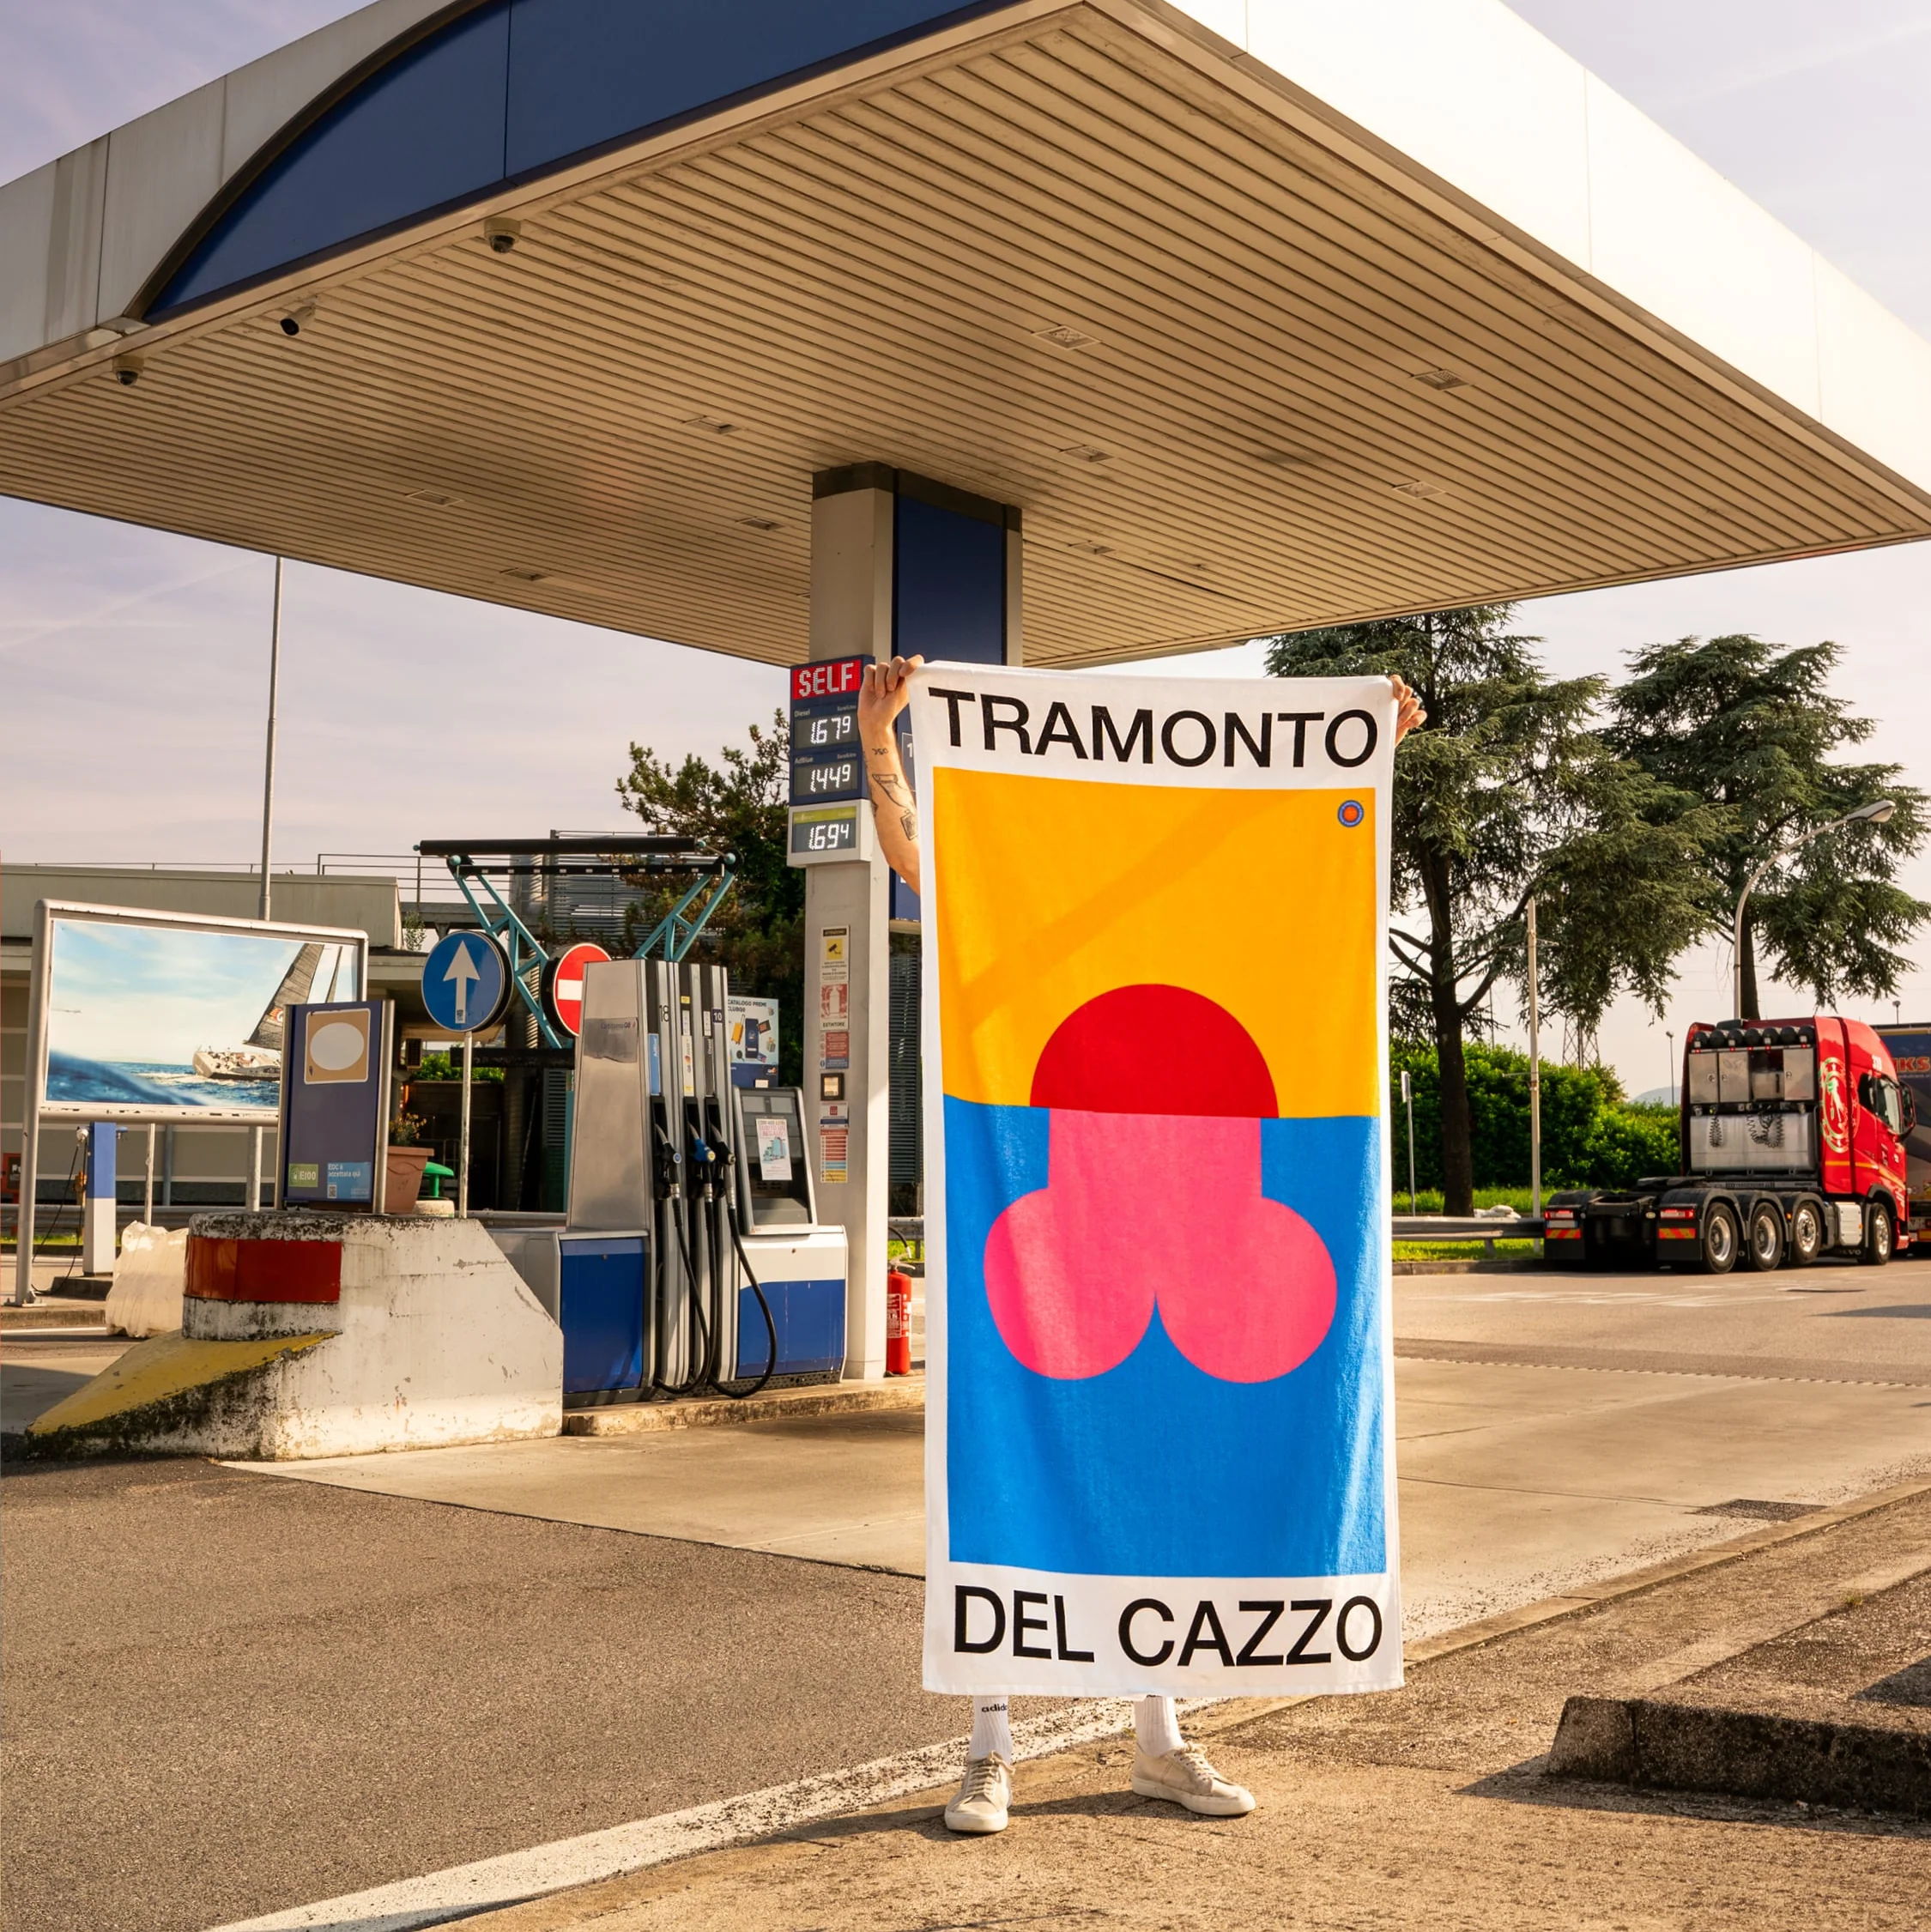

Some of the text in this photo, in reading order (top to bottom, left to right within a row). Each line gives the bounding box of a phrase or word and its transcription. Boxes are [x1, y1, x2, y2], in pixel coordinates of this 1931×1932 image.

[798, 662, 855, 697] SELF
[794, 708, 811, 718] Diesel
[928, 687, 1377, 767] TRAMONTO
[809, 764, 851, 792] 1449
[808, 823, 850, 851] 1694
[658, 1004, 669, 1022] 18
[713, 1012, 723, 1021] 10
[953, 1584, 1383, 1668] DEL CAZZO
